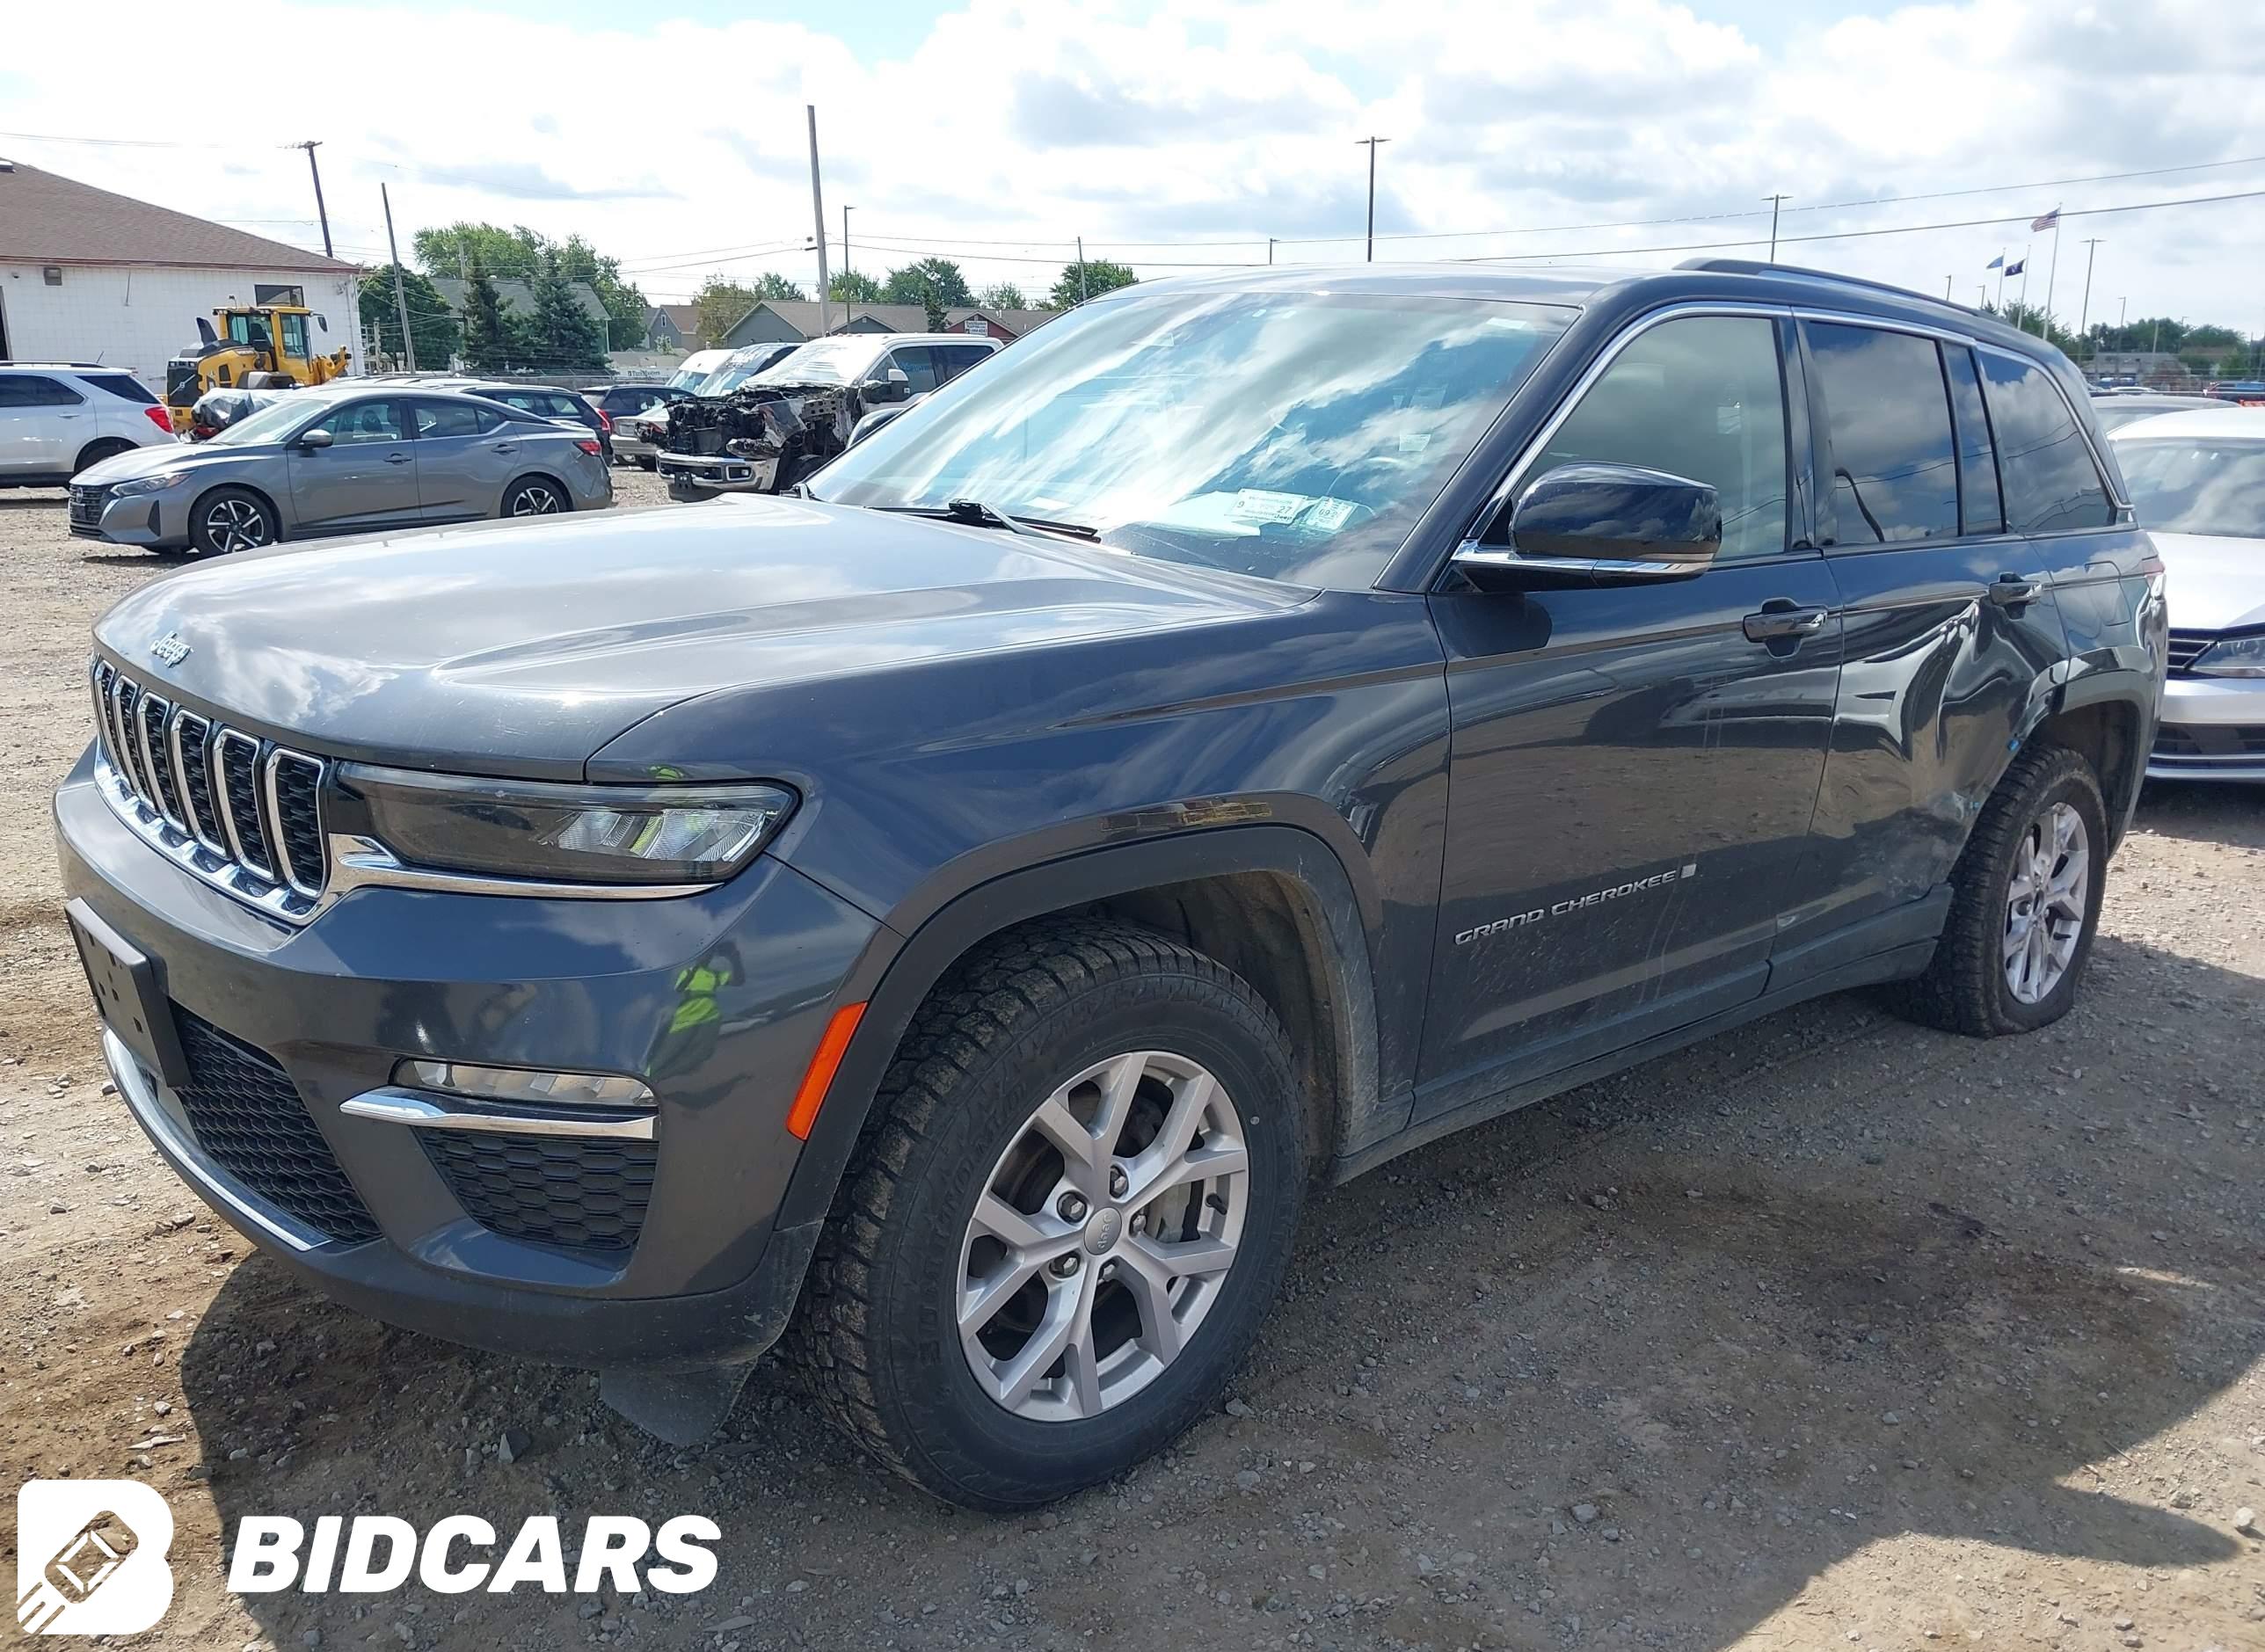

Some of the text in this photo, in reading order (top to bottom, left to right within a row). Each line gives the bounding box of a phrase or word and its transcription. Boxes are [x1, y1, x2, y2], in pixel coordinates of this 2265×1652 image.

[149, 630, 192, 667] Jeep
[1454, 870, 1677, 946] GRAND CHEROKEE
[1096, 1212, 1112, 1250] Jeep
